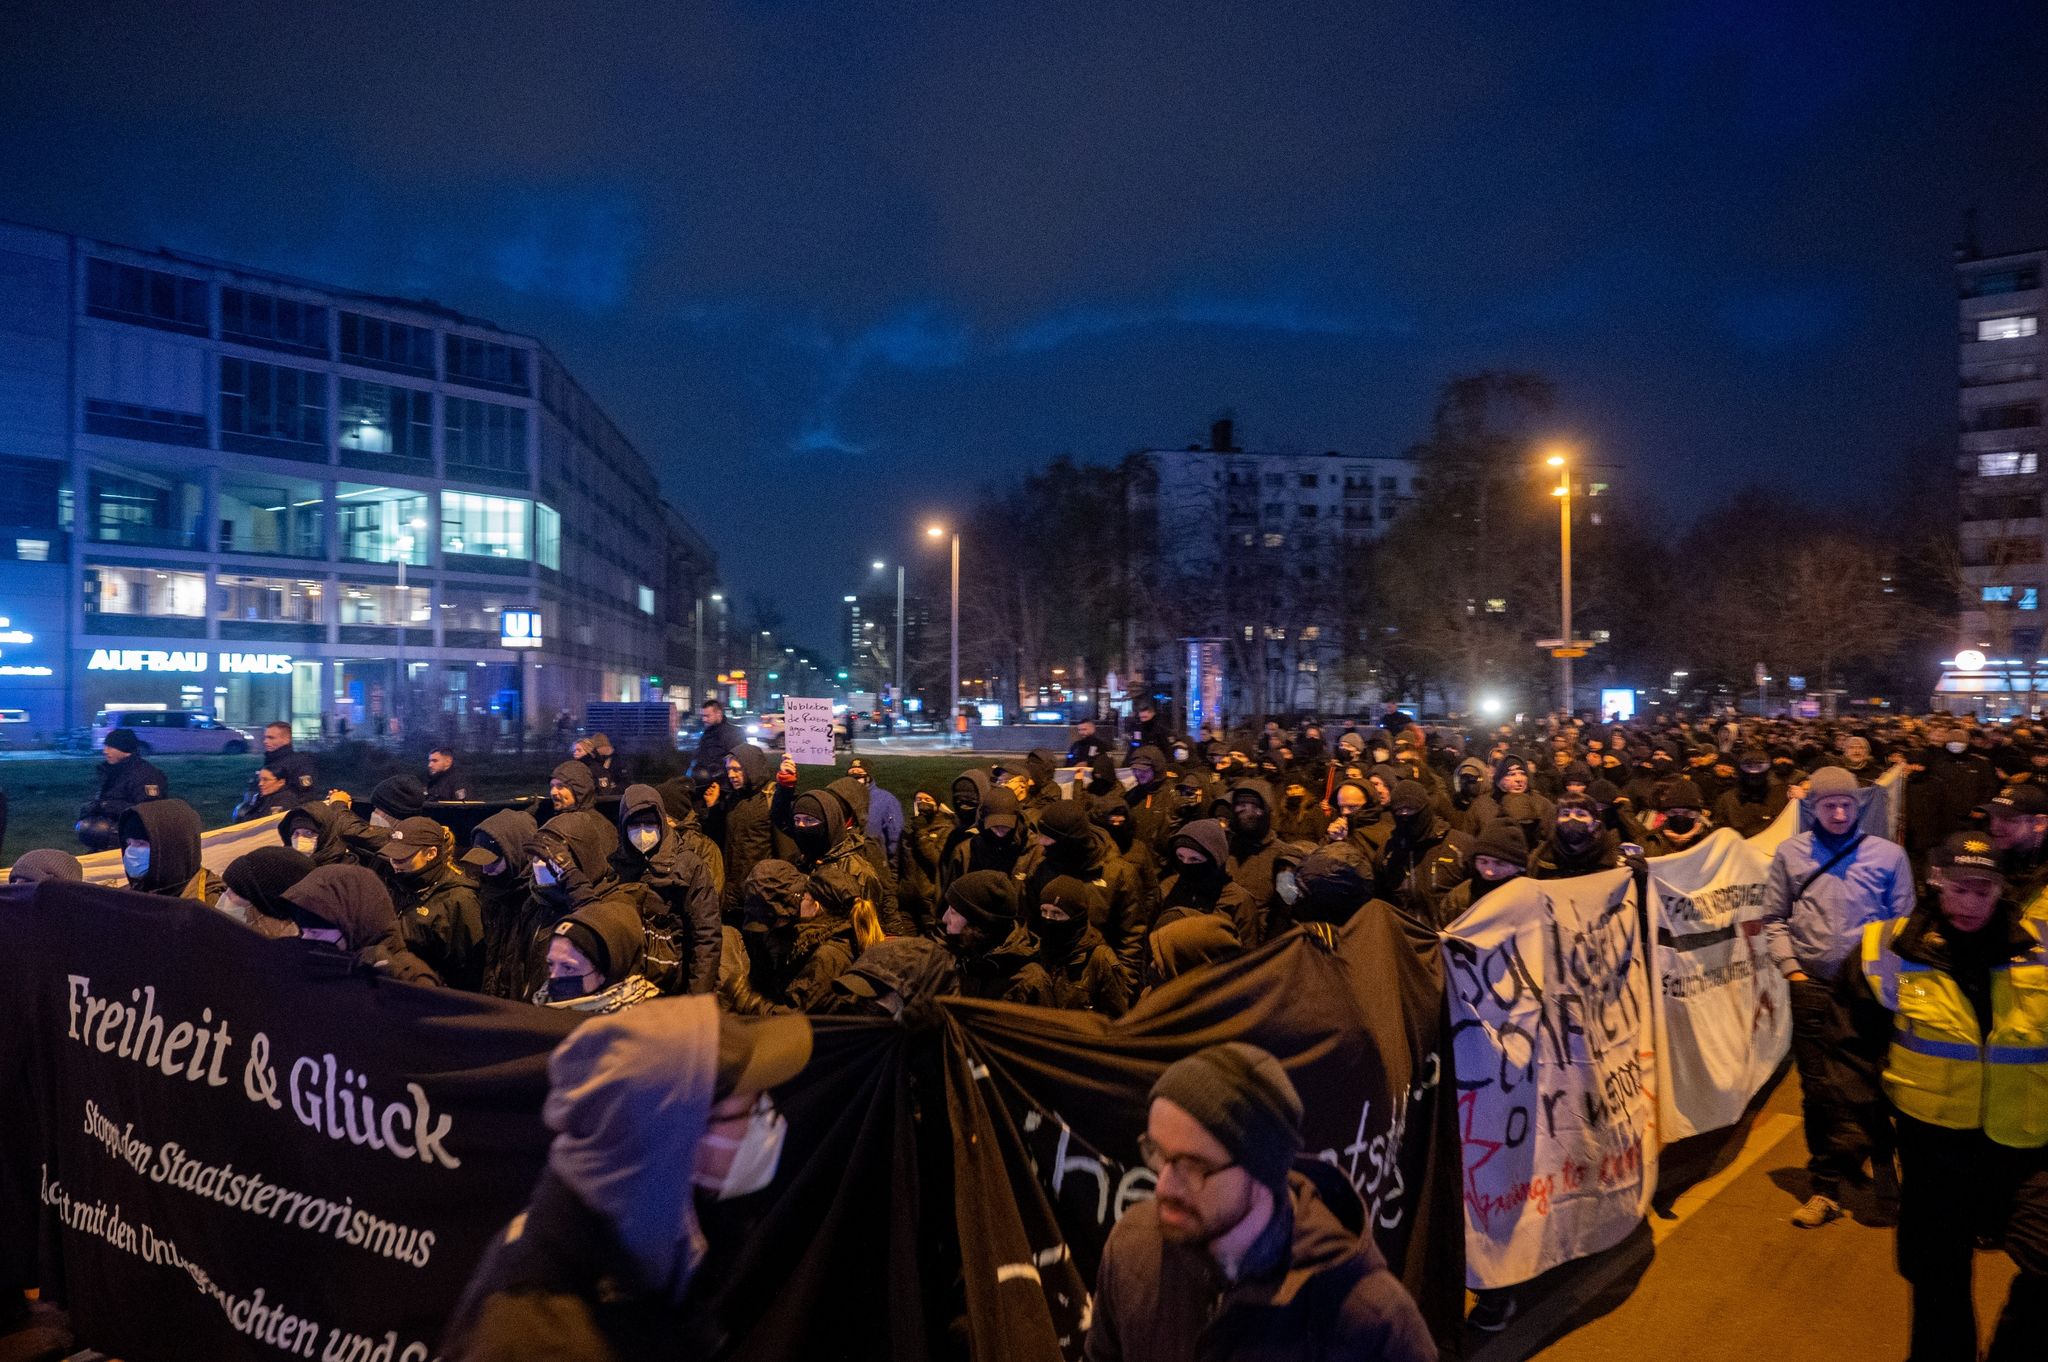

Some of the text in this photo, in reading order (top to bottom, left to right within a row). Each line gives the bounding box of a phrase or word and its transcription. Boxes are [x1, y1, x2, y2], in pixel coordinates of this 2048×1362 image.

[87, 649, 293, 674] AUFBAU HAUS
[68, 974, 461, 1169] Freiheit & Glück
[72, 1199, 108, 1237] mit
[106, 1204, 138, 1255] den
[121, 1123, 152, 1175] den
[150, 1141, 436, 1268] Staatsterrorismus
